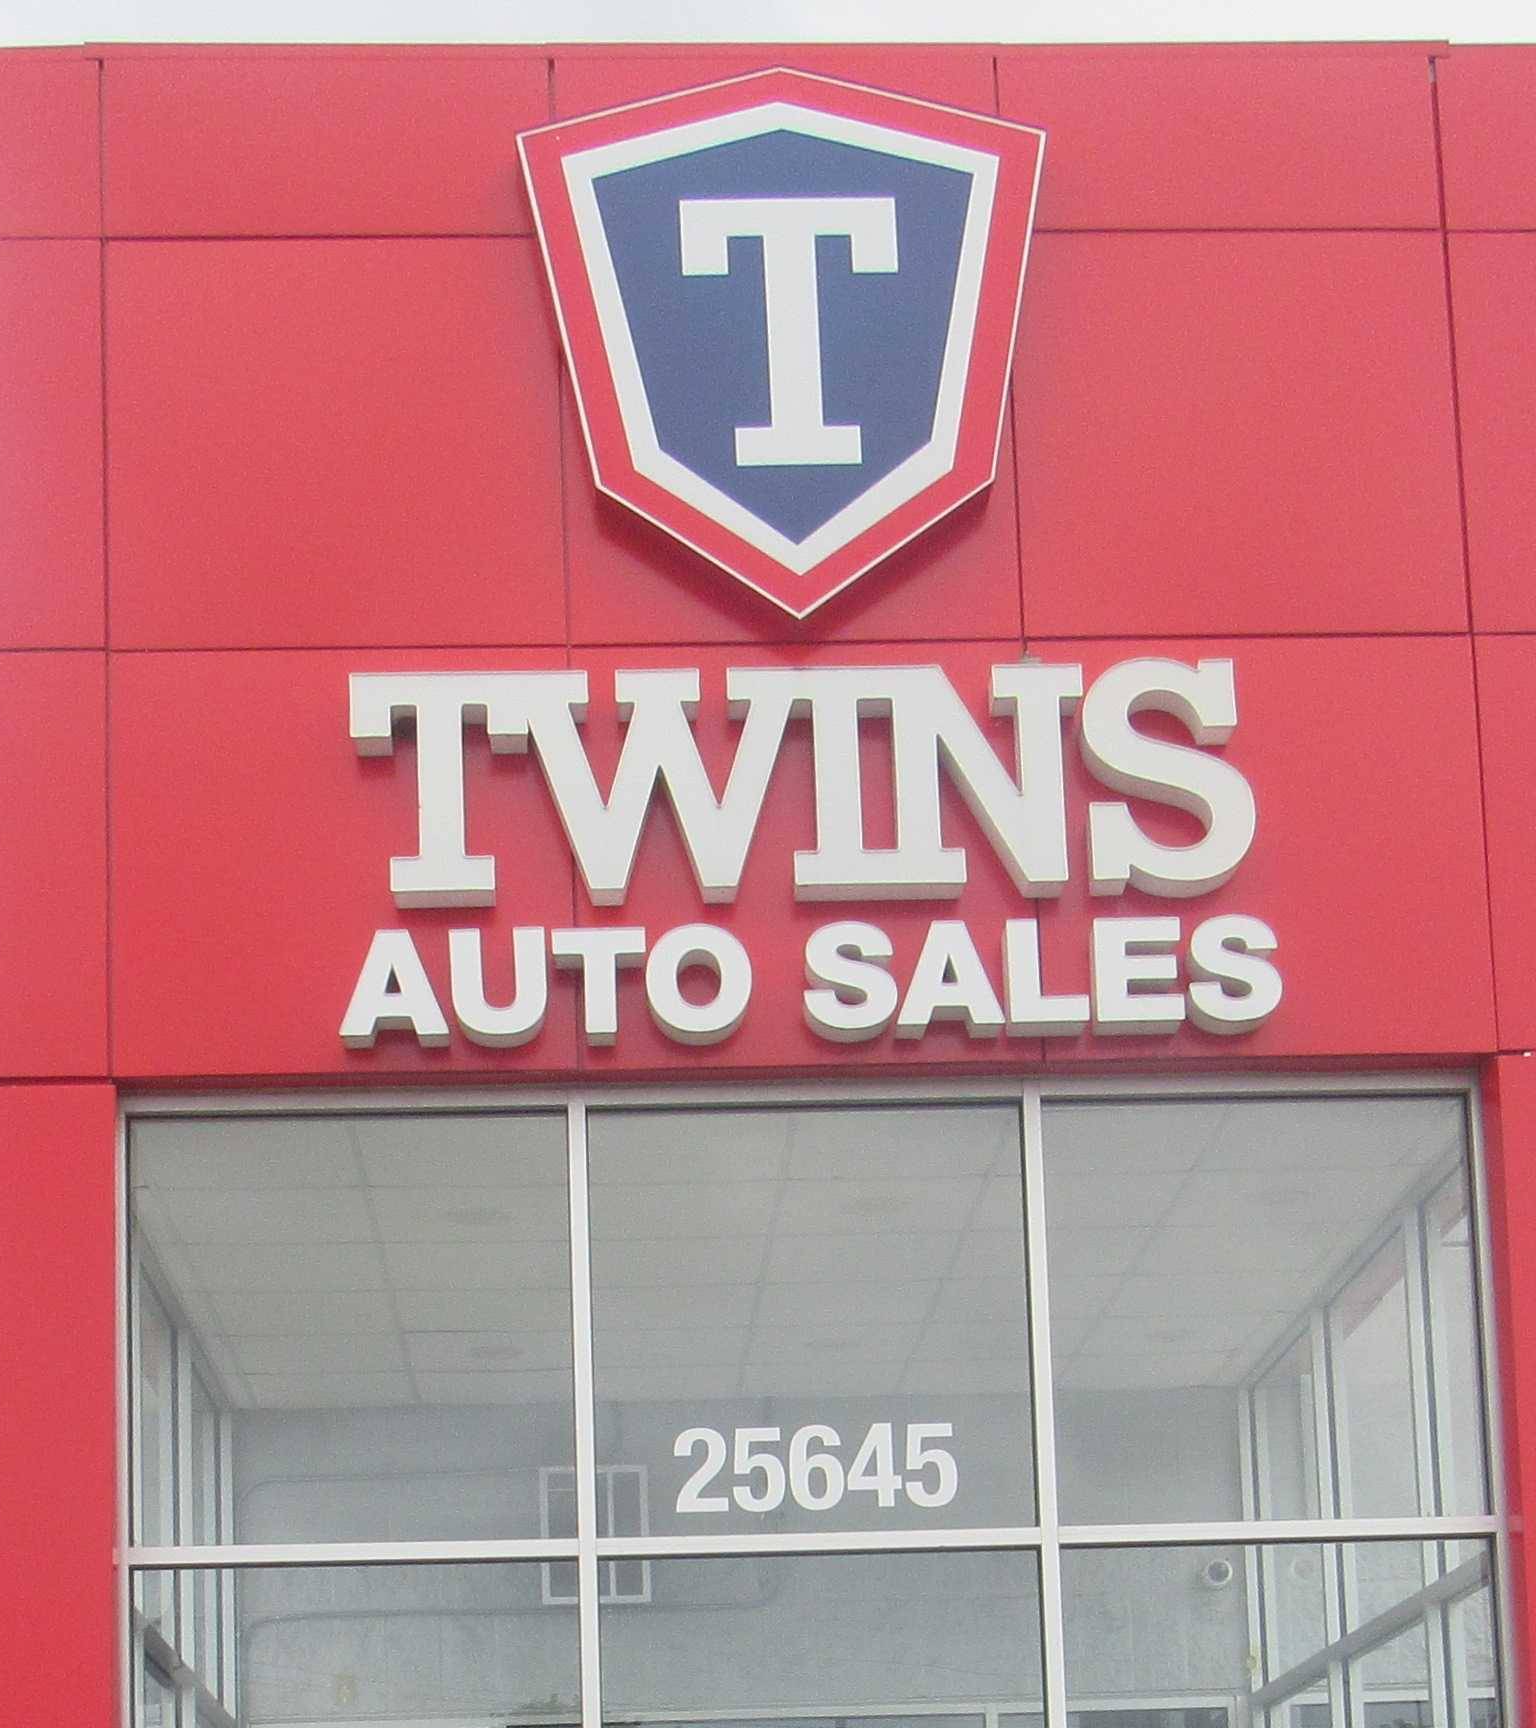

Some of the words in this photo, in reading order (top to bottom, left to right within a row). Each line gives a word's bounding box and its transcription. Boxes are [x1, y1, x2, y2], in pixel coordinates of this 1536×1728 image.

[679, 196, 899, 467] T
[348, 657, 1256, 908] TWINS
[339, 923, 753, 1049] AUTO
[803, 914, 1284, 1044] SALES
[672, 1422, 959, 1515] 25645
